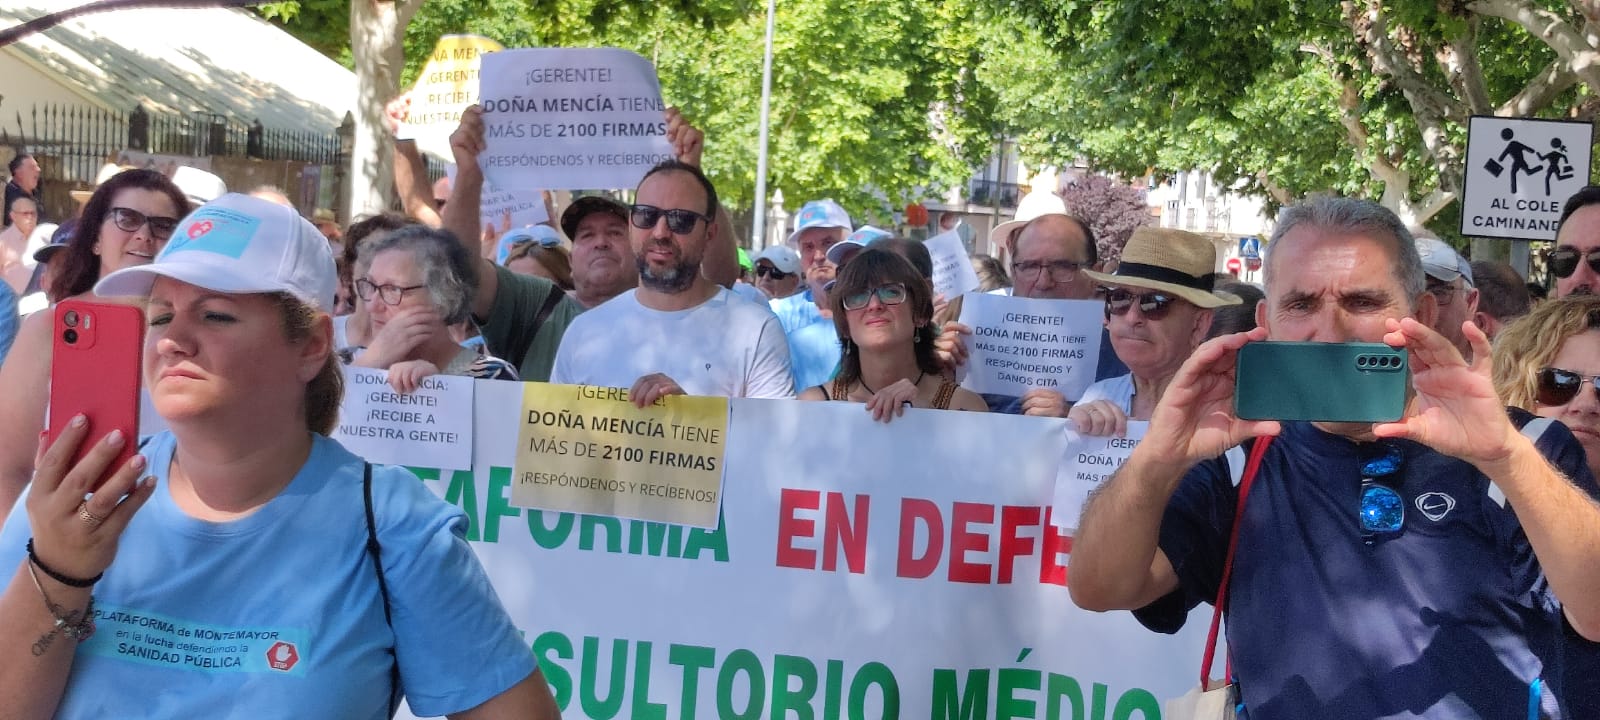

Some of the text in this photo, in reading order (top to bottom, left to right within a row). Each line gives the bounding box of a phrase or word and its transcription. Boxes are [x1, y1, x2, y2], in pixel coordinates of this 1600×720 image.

[426, 70, 480, 85] ¡GERENT
[525, 68, 612, 86] ¡GERENTE!
[484, 96, 536, 113] DOÑA
[542, 93, 614, 113] MENCÍA
[617, 97, 665, 112] TIENE
[489, 120, 666, 138] MÁS DE 2100 FIRMAS
[485, 152, 585, 169] ¡RESPÓNDENOS
[587, 154, 595, 166] Y
[1490, 198, 1559, 212] AL COLE
[1472, 215, 1559, 232] CAMINAND
[1002, 312, 1064, 327] ¡GERENTE!
[975, 325, 1009, 339] DOÑA
[1061, 335, 1087, 345] TIENE
[997, 345, 1010, 354] DE
[1013, 346, 1039, 358] 2100
[1041, 348, 1085, 359] FIRMAS
[985, 357, 1073, 374] RESPÓNDENOS Y
[1036, 378, 1058, 387] CITA
[365, 391, 438, 407] ¡GERENTE!
[577, 385, 666, 407] ¡GEREE!
[366, 409, 435, 425] ¡RECIBE A
[528, 408, 720, 444] DOÑA MENCÍA TIENE
[340, 425, 459, 444] NUESTRA GENTE!
[529, 436, 716, 472] MÁS DE 2100 FIRMAS
[1078, 453, 1113, 466] DOÑA
[520, 471, 717, 504] ¡RESPÓNDENOS Y RECÍBENOS!
[775, 487, 871, 575] EN
[896, 496, 1073, 588] DEFE
[93, 609, 280, 641] PLATAFORMA de MONTEMAYOR
[116, 629, 249, 654] en la lucha defendiendo la
[117, 642, 241, 668] SANIDAD PÚBLICA
[520, 630, 901, 720] SULTORIO
